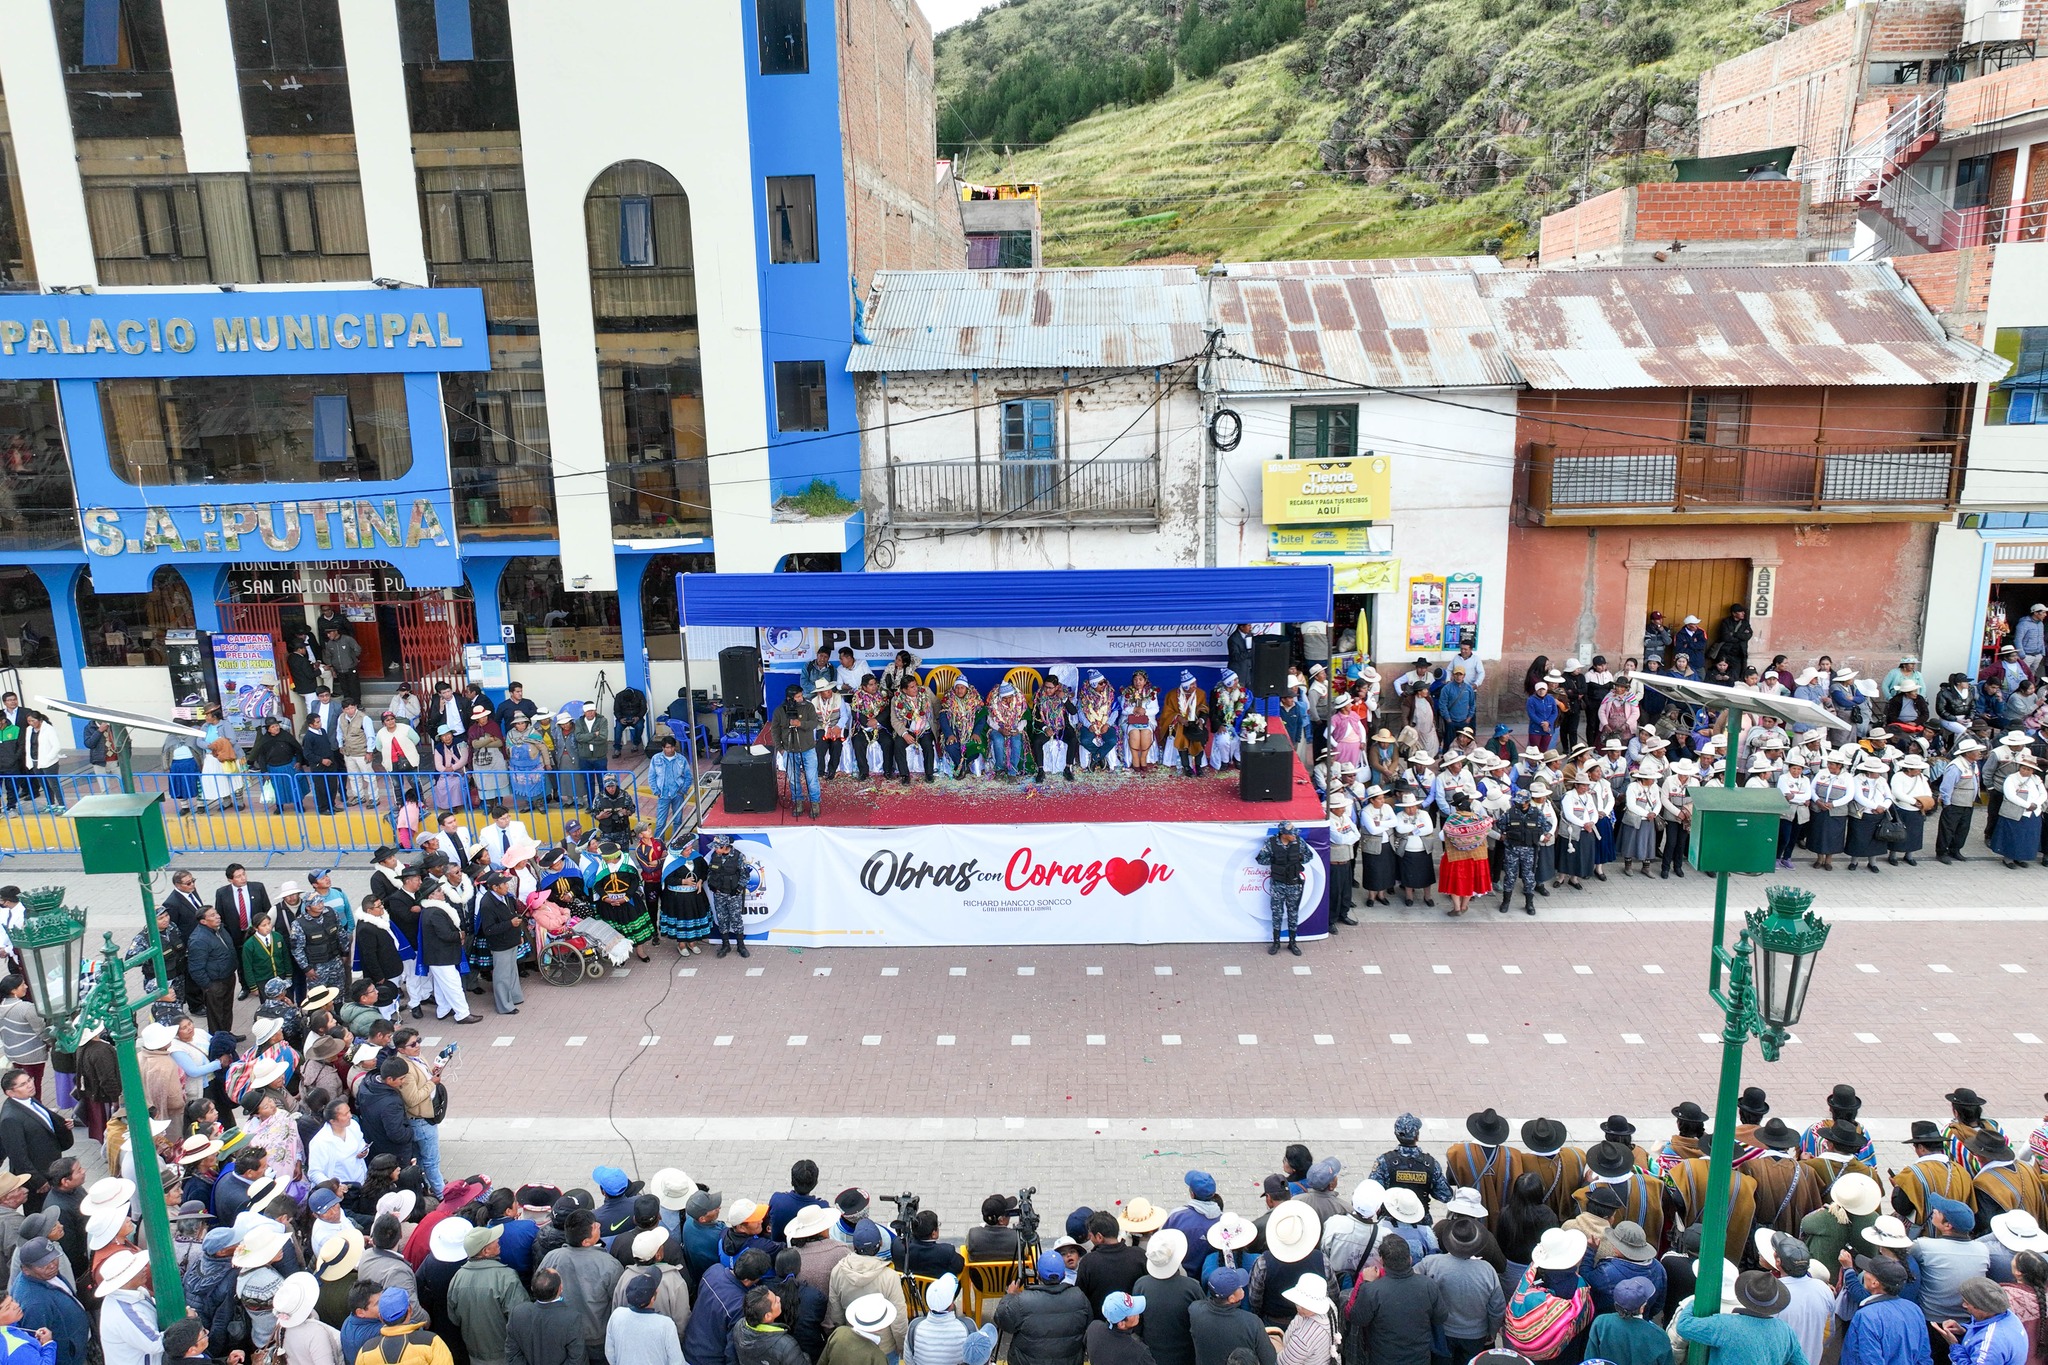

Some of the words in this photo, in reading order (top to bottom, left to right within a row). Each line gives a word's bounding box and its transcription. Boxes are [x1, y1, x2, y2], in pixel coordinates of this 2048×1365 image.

[0, 317, 197, 355] PALACIO
[212, 312, 463, 352] MUNICIPAL
[1309, 471, 1354, 484] Tienda
[1302, 482, 1358, 495] Chévere
[1317, 505, 1340, 515] AQUÍ
[84, 504, 201, 557] S.A.
[220, 498, 450, 553] PUTINA
[1280, 534, 1304, 543] bitel
[242, 579, 274, 594] SAN
[282, 578, 347, 594] ANTONIO
[355, 577, 377, 593] DE
[1755, 566, 1771, 616] ABOGADO
[822, 627, 934, 650] PUNO
[1186, 640, 1223, 648] SONCCO
[860, 849, 979, 896] Obras
[977, 870, 1004, 882] con
[963, 899, 999, 907] RICHARD
[1000, 899, 1036, 907] HANCCO
[1037, 898, 1072, 906] SONCCO
[741, 906, 769, 915] UNO
[1397, 1172, 1426, 1182] SERENAZGO
